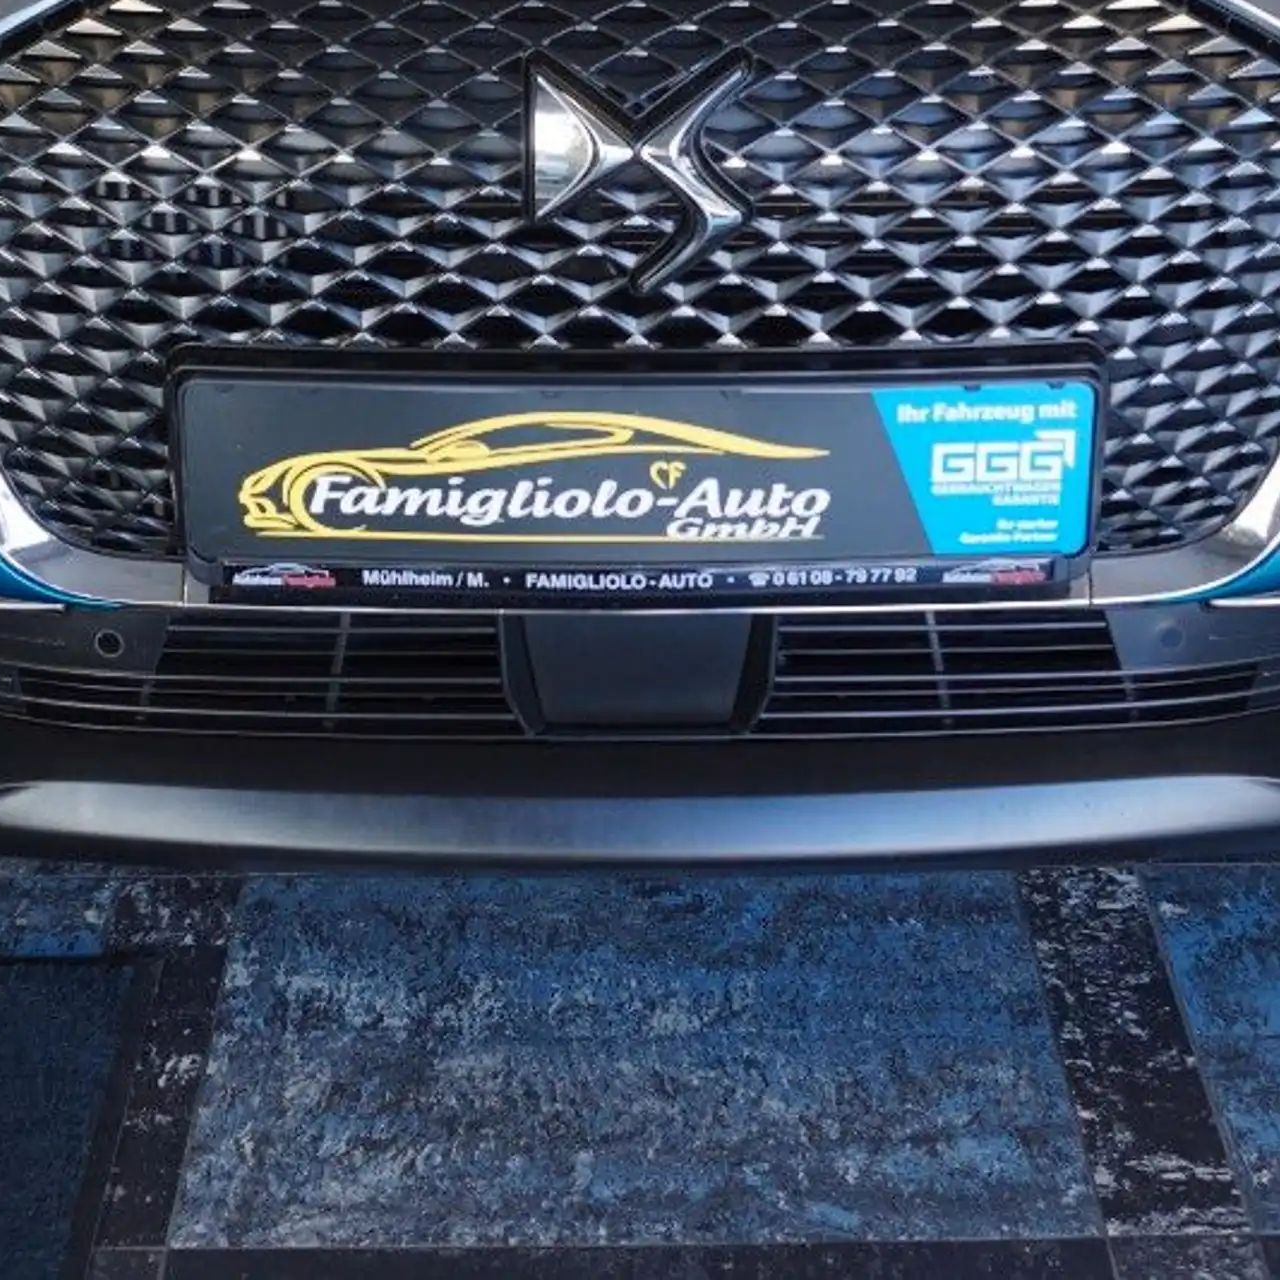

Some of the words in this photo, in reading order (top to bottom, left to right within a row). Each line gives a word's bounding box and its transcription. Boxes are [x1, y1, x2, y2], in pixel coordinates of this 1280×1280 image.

[896, 403, 930, 424] Ihr
[933, 401, 1035, 425] Fahrzeug
[1039, 399, 1078, 418] mit
[931, 438, 1064, 484] GGG
